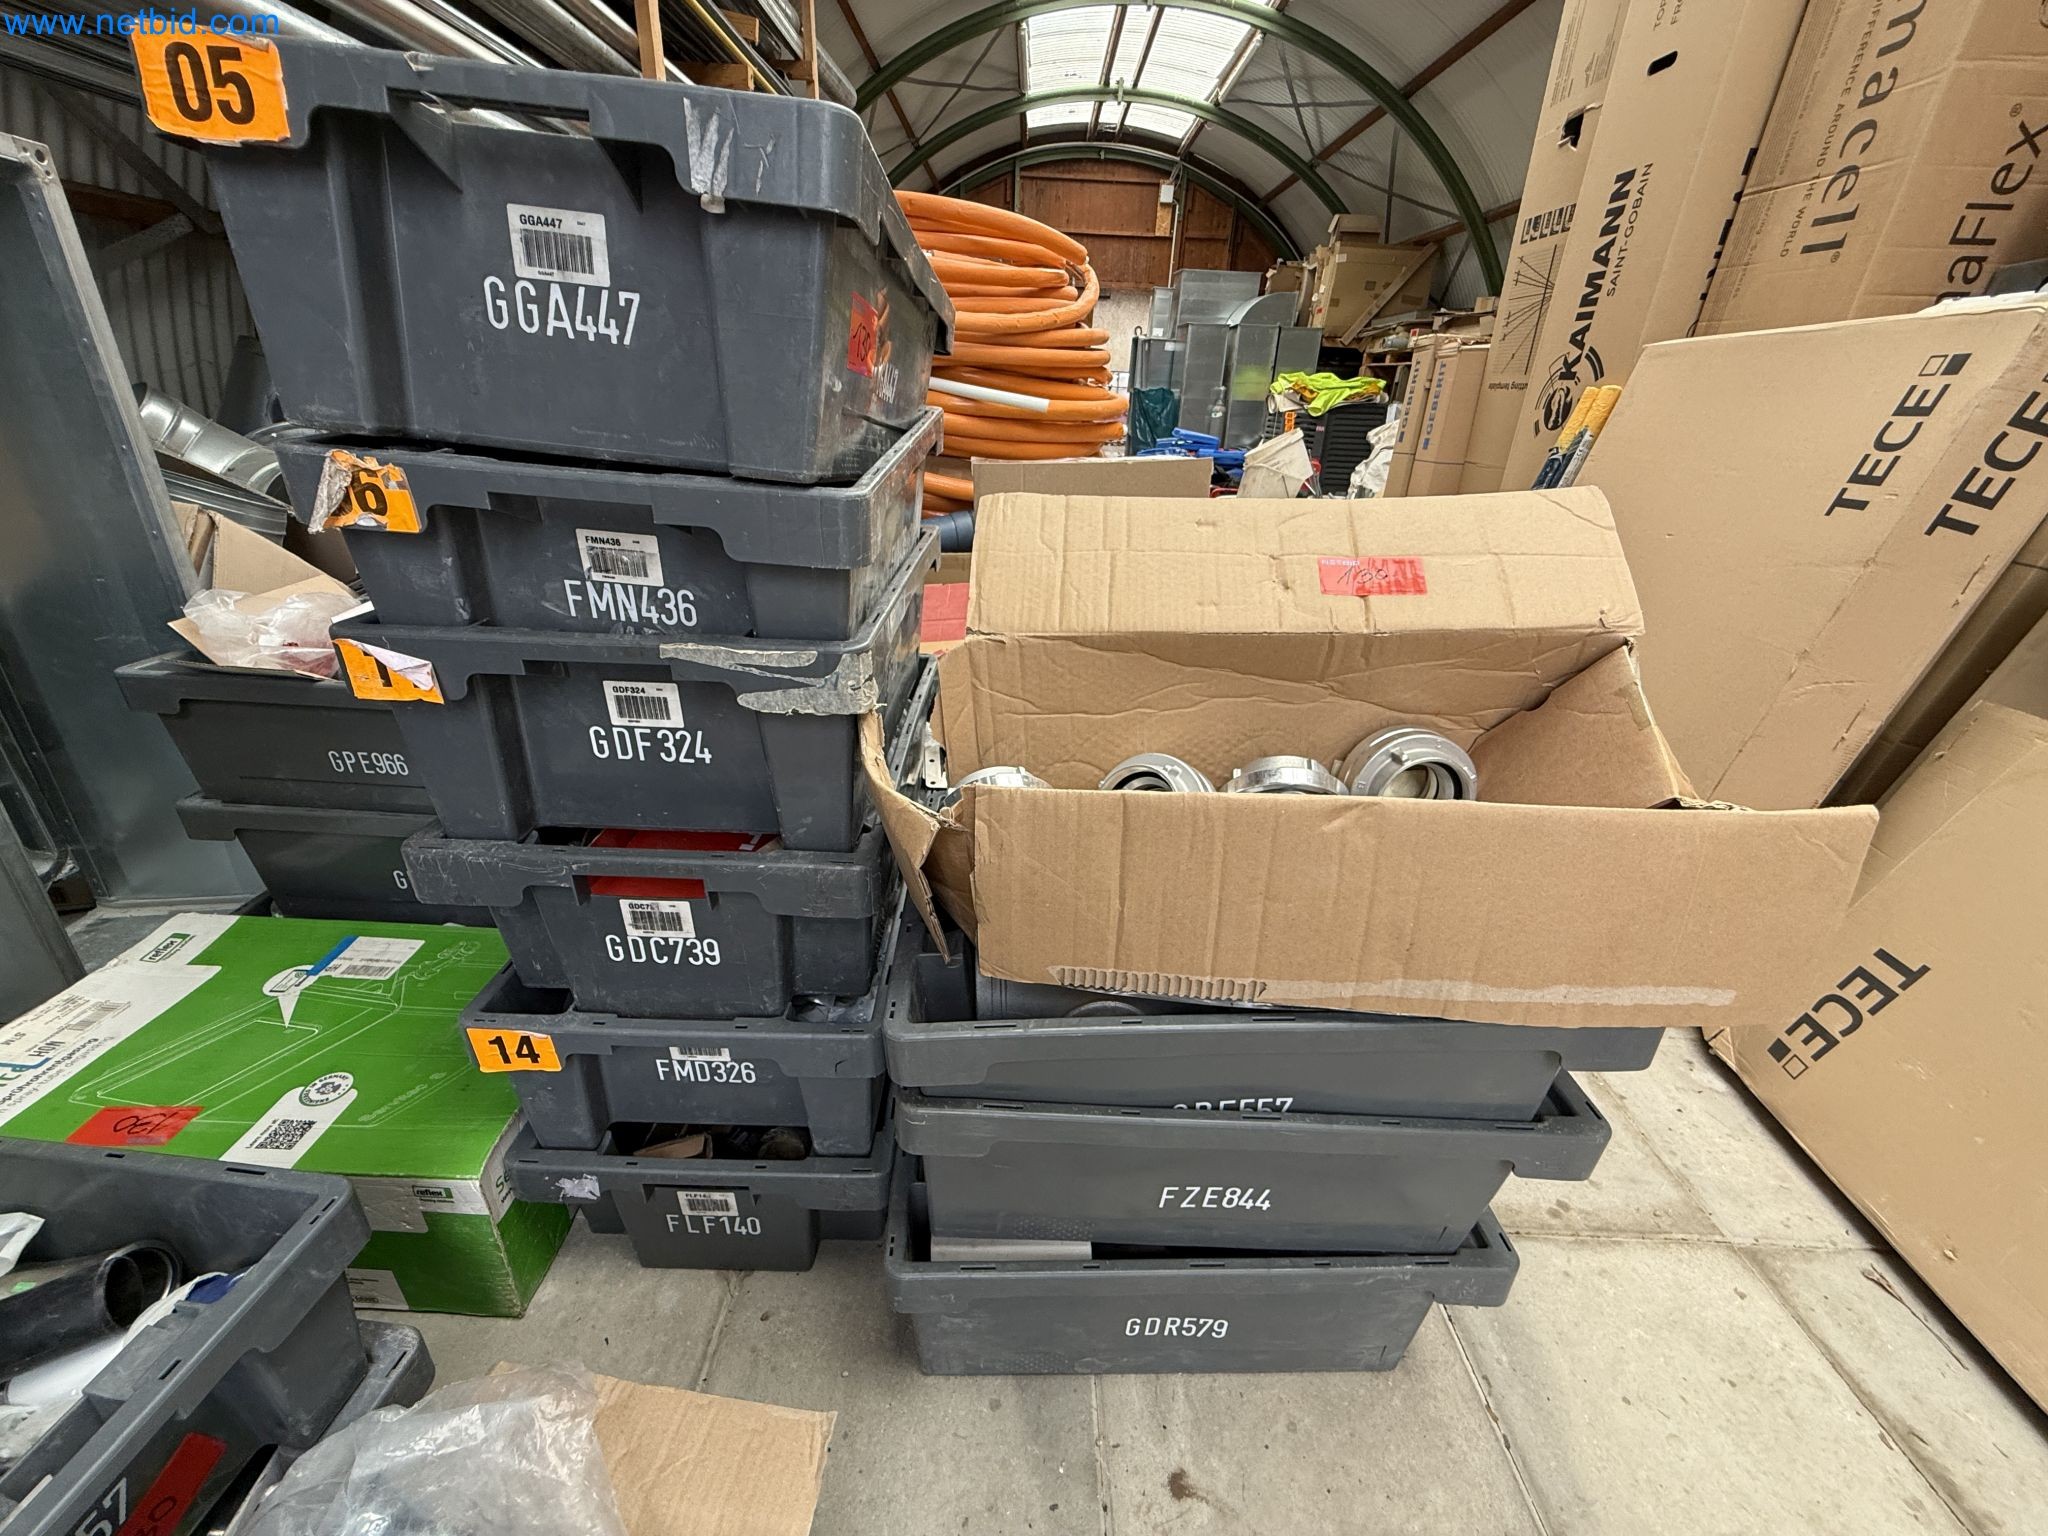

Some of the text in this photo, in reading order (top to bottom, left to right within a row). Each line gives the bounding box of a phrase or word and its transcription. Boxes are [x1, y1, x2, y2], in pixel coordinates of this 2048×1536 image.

[165, 41, 256, 125] 05
[1816, 103, 1845, 167] AROUND
[519, 213, 563, 229] GGA447
[1607, 162, 1654, 297] SAINT-GOBAIN
[1780, 206, 1807, 257] WORLD
[1558, 168, 1637, 381] KAIMANN
[484, 276, 640, 345] GGA447
[1824, 384, 1951, 517] TECE
[1924, 391, 2048, 536] TECE
[563, 579, 698, 627] FMN436
[612, 685, 646, 695] GDF324
[328, 751, 409, 776] GPE966
[588, 725, 713, 764] GDF324
[605, 934, 721, 966] GDC739
[1785, 948, 1931, 1062] TECE
[488, 1035, 541, 1065] 14
[656, 1058, 757, 1084] FMD326
[1158, 1186, 1272, 1212] FZE844
[665, 1214, 762, 1236] FLF140
[1124, 1316, 1229, 1340] GDR579
